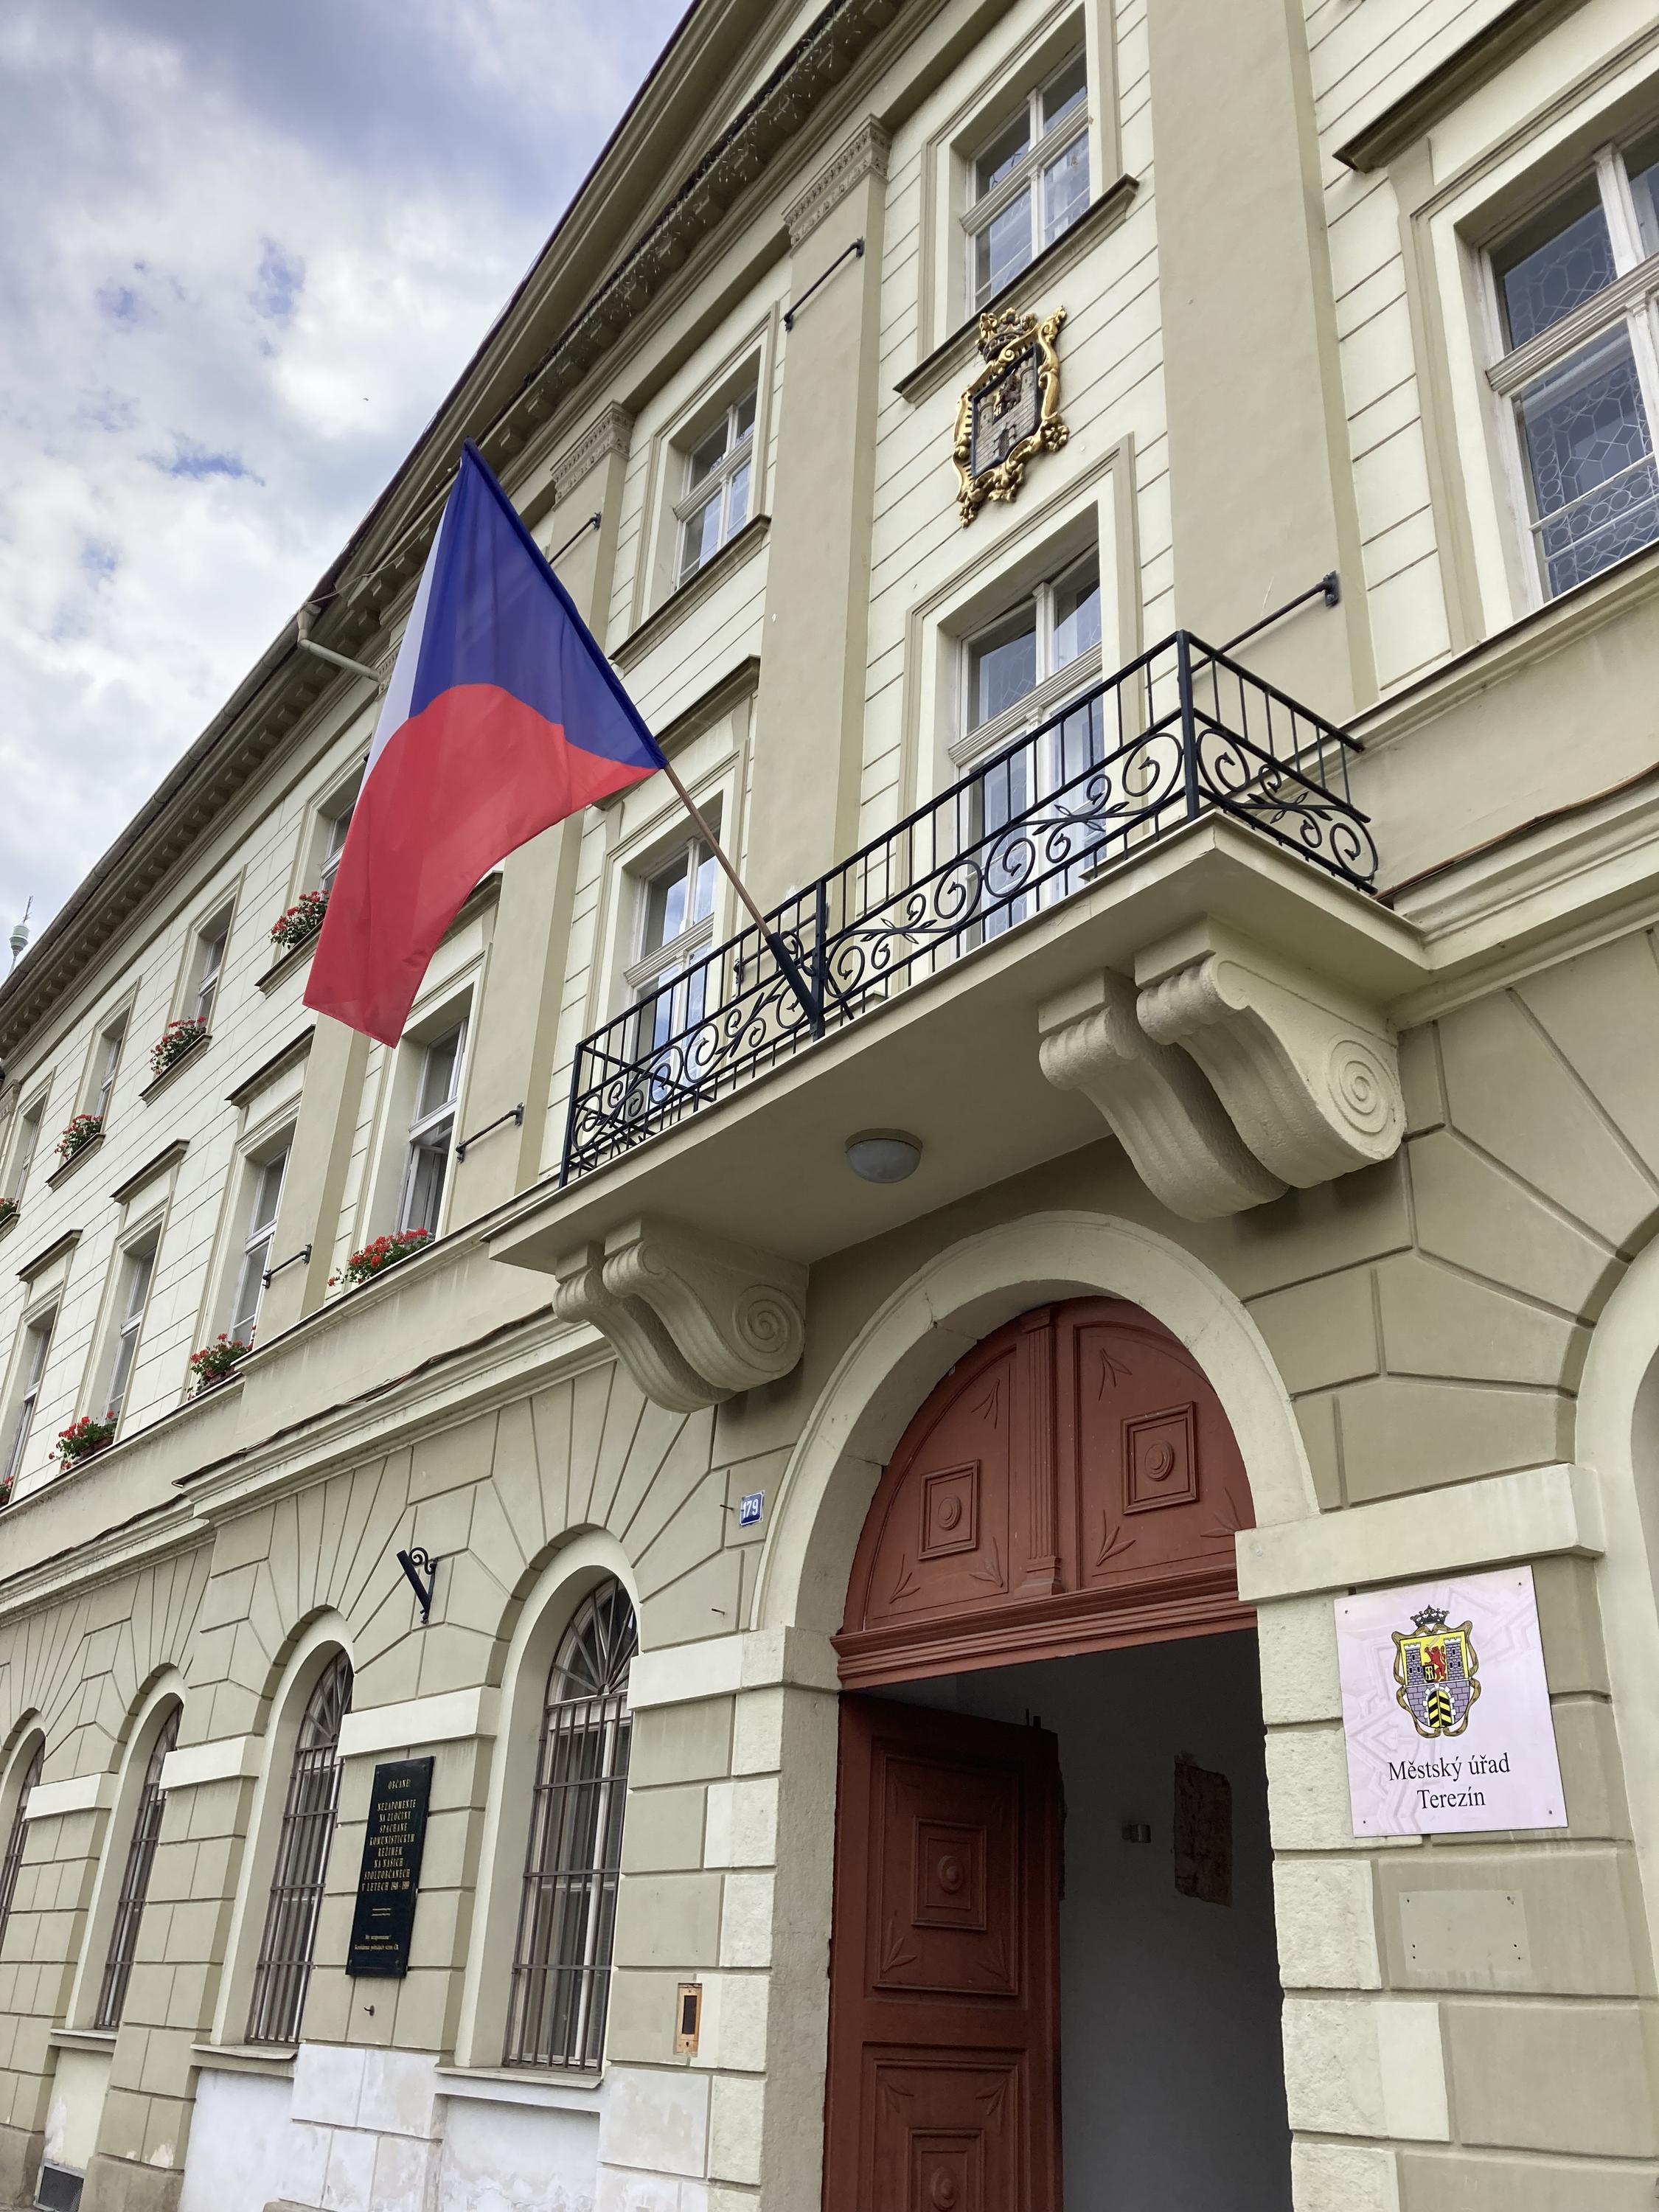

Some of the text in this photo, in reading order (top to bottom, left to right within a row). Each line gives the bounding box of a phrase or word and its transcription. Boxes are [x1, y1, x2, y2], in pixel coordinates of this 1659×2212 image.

[743, 1498, 759, 1519] 179
[1388, 1752, 1511, 1782] Městský úřad
[1416, 1787, 1486, 1809] Terezín
[379, 1813, 386, 1822] NA
[374, 1860, 381, 1868] NA
[366, 1882, 389, 1891] LETECH
